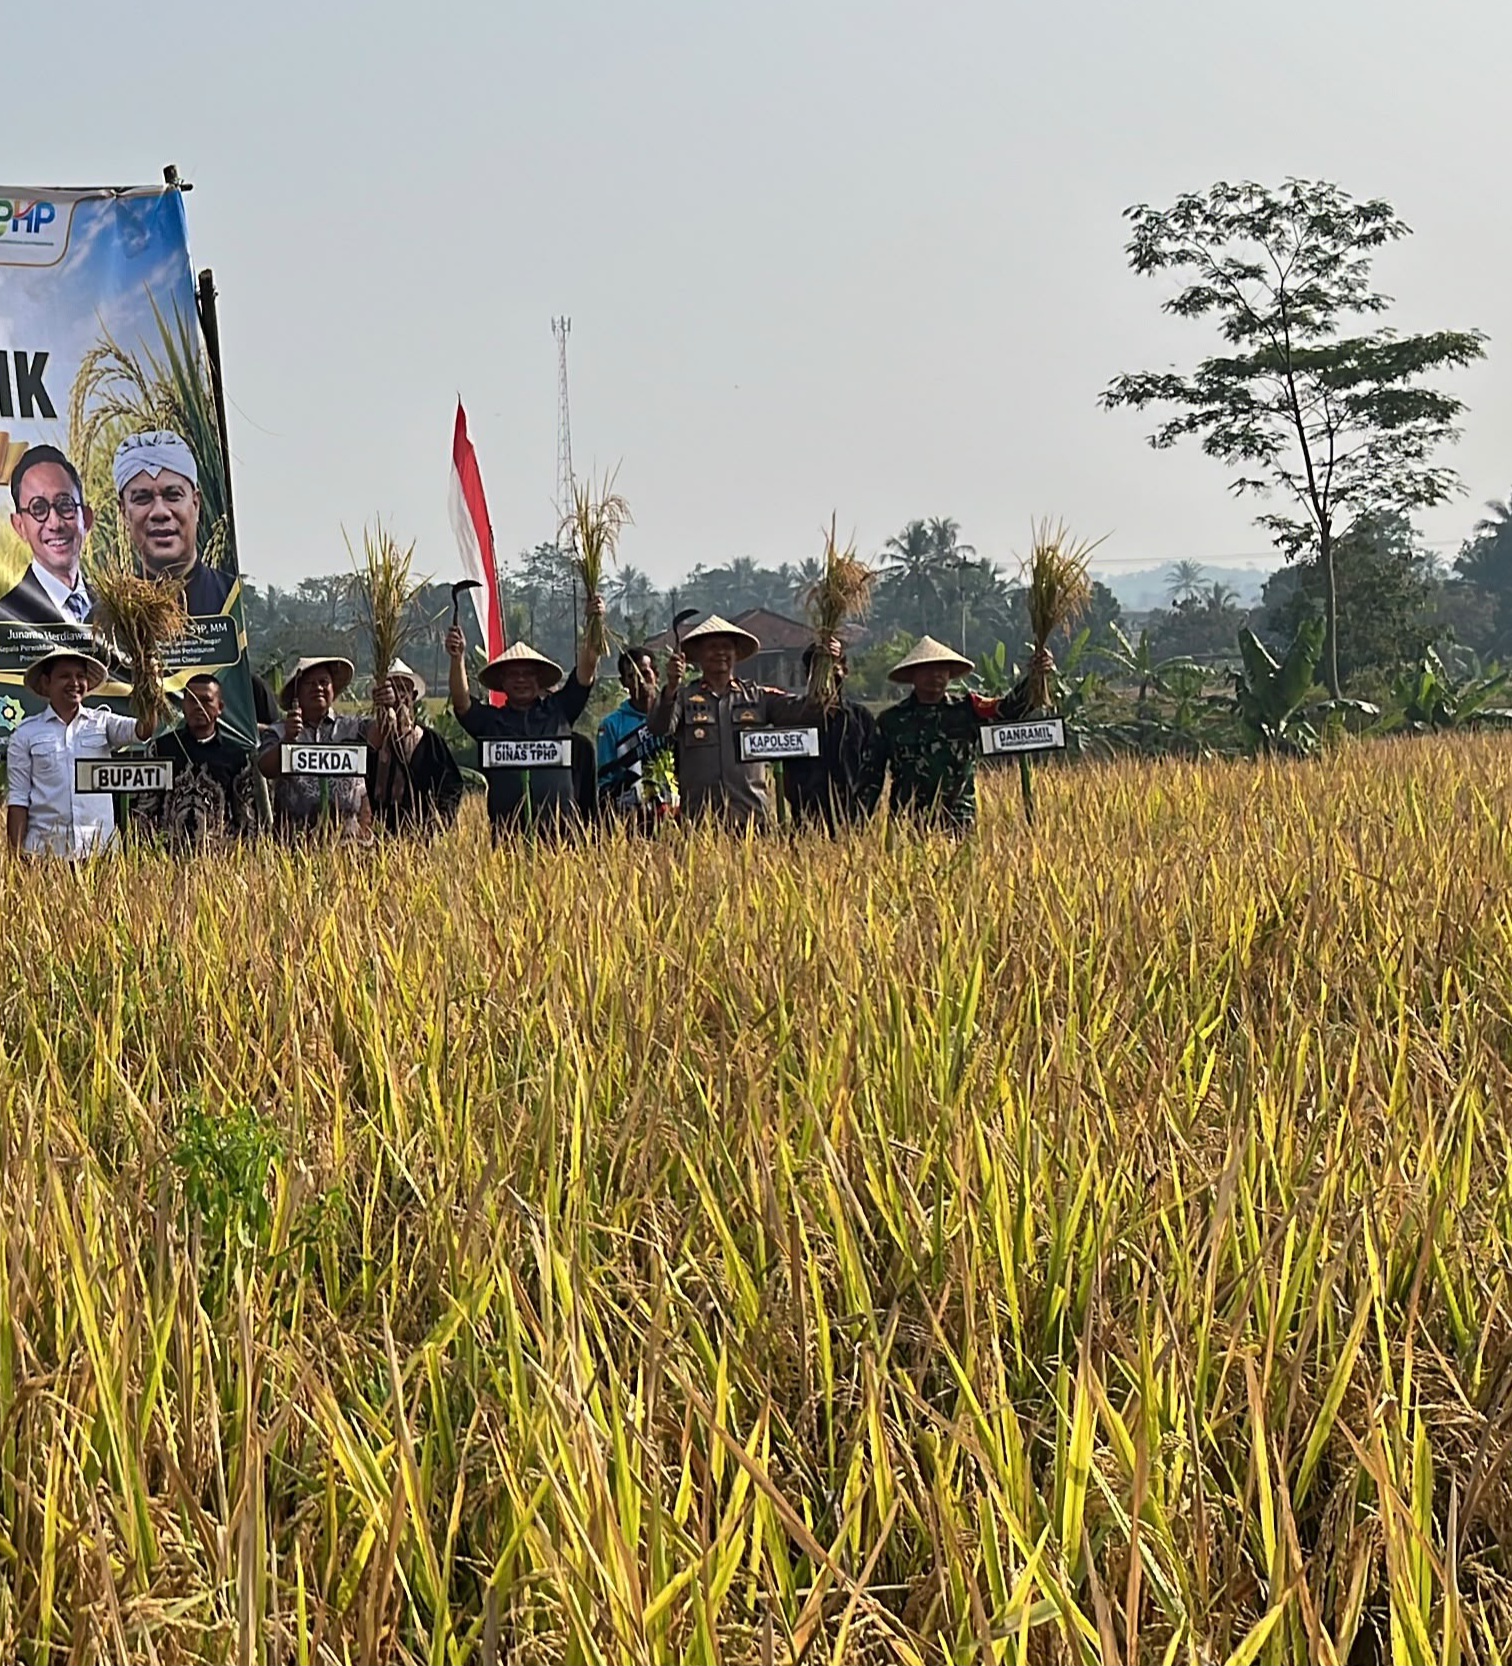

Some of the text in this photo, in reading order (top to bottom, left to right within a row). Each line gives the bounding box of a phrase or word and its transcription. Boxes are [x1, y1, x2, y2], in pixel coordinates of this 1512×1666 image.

[749, 734, 803, 747] KAPOLSEK
[999, 727, 1052, 743] DANRAMIL
[296, 752, 353, 771] SEKDA
[495, 749, 558, 761] DINAS TPHP
[97, 767, 161, 788] BUPATI
